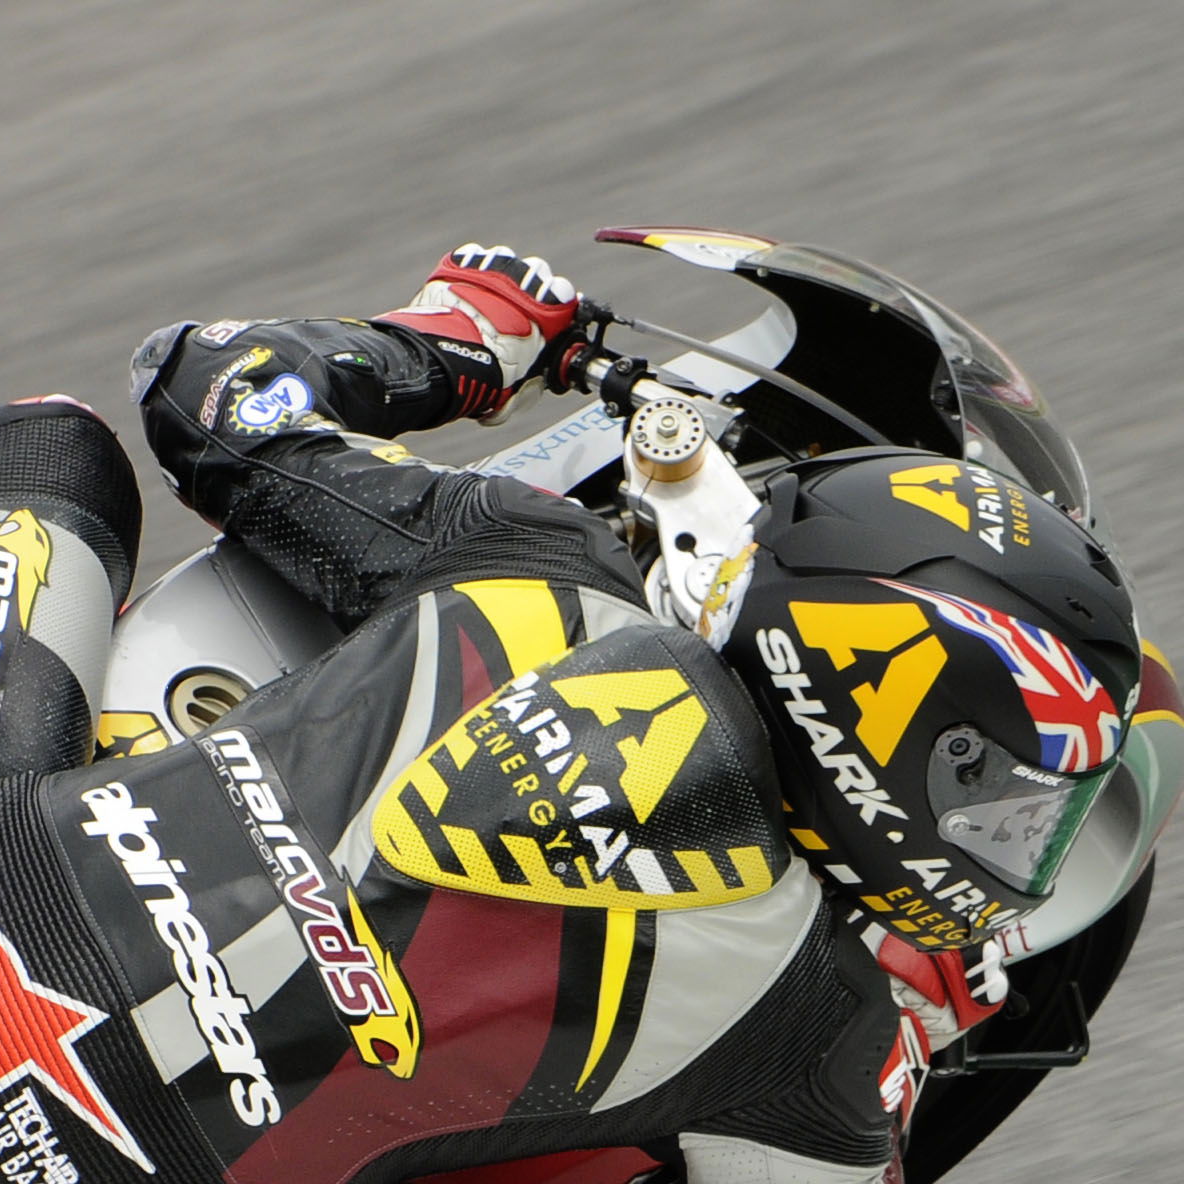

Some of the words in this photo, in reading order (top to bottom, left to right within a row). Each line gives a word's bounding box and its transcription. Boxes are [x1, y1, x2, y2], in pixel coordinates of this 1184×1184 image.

[488, 405, 625, 478] EurAsi
[476, 719, 570, 850] ENERGY
[81, 781, 282, 1126] alpinestars
[885, 887, 978, 946] ENERG
